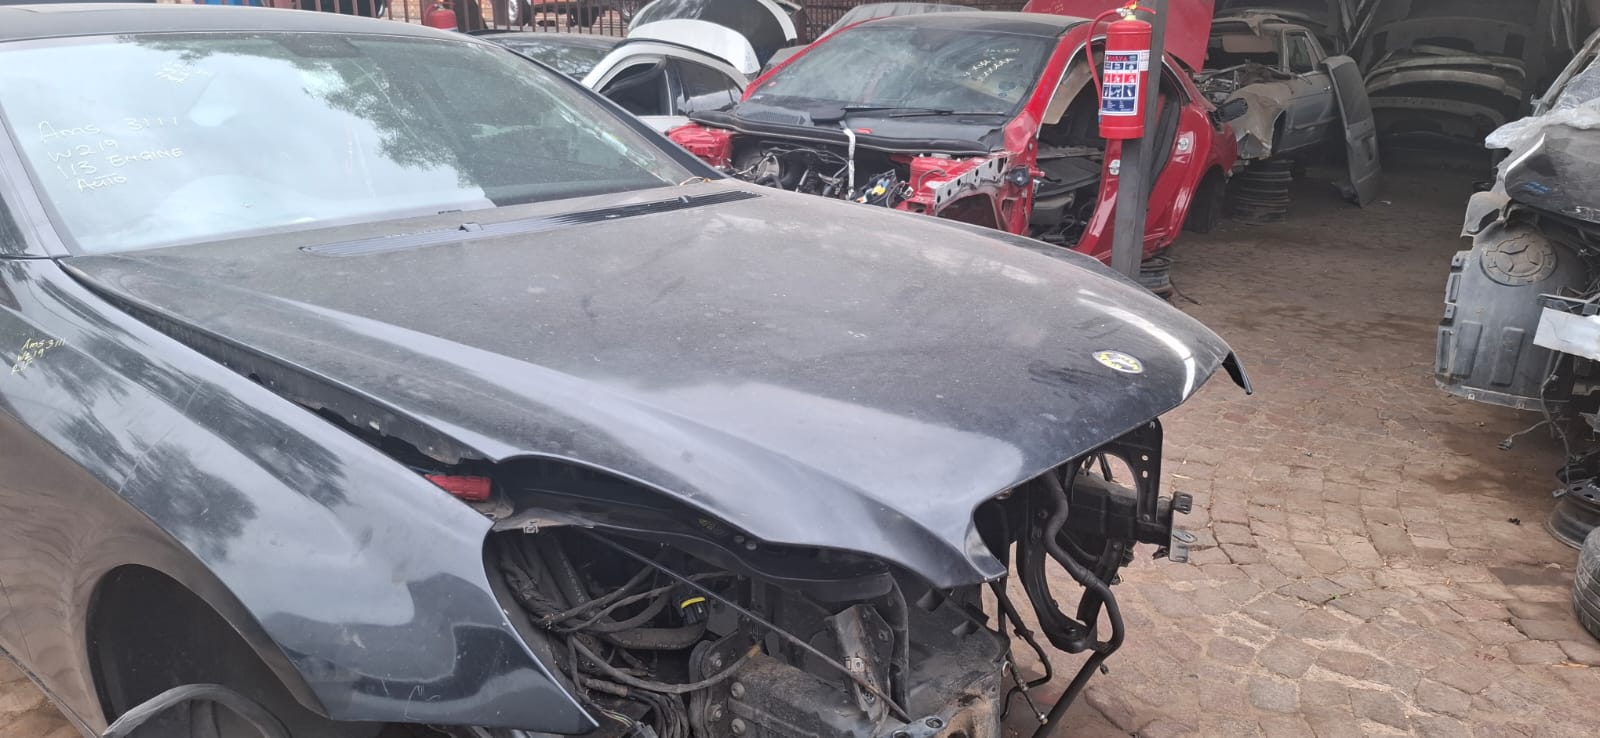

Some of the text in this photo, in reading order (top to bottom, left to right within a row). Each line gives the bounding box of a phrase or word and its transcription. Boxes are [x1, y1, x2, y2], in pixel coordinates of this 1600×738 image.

[124, 116, 178, 131] 3111
[47, 139, 119, 162] W219
[56, 147, 185, 179] 113 ENGINE
